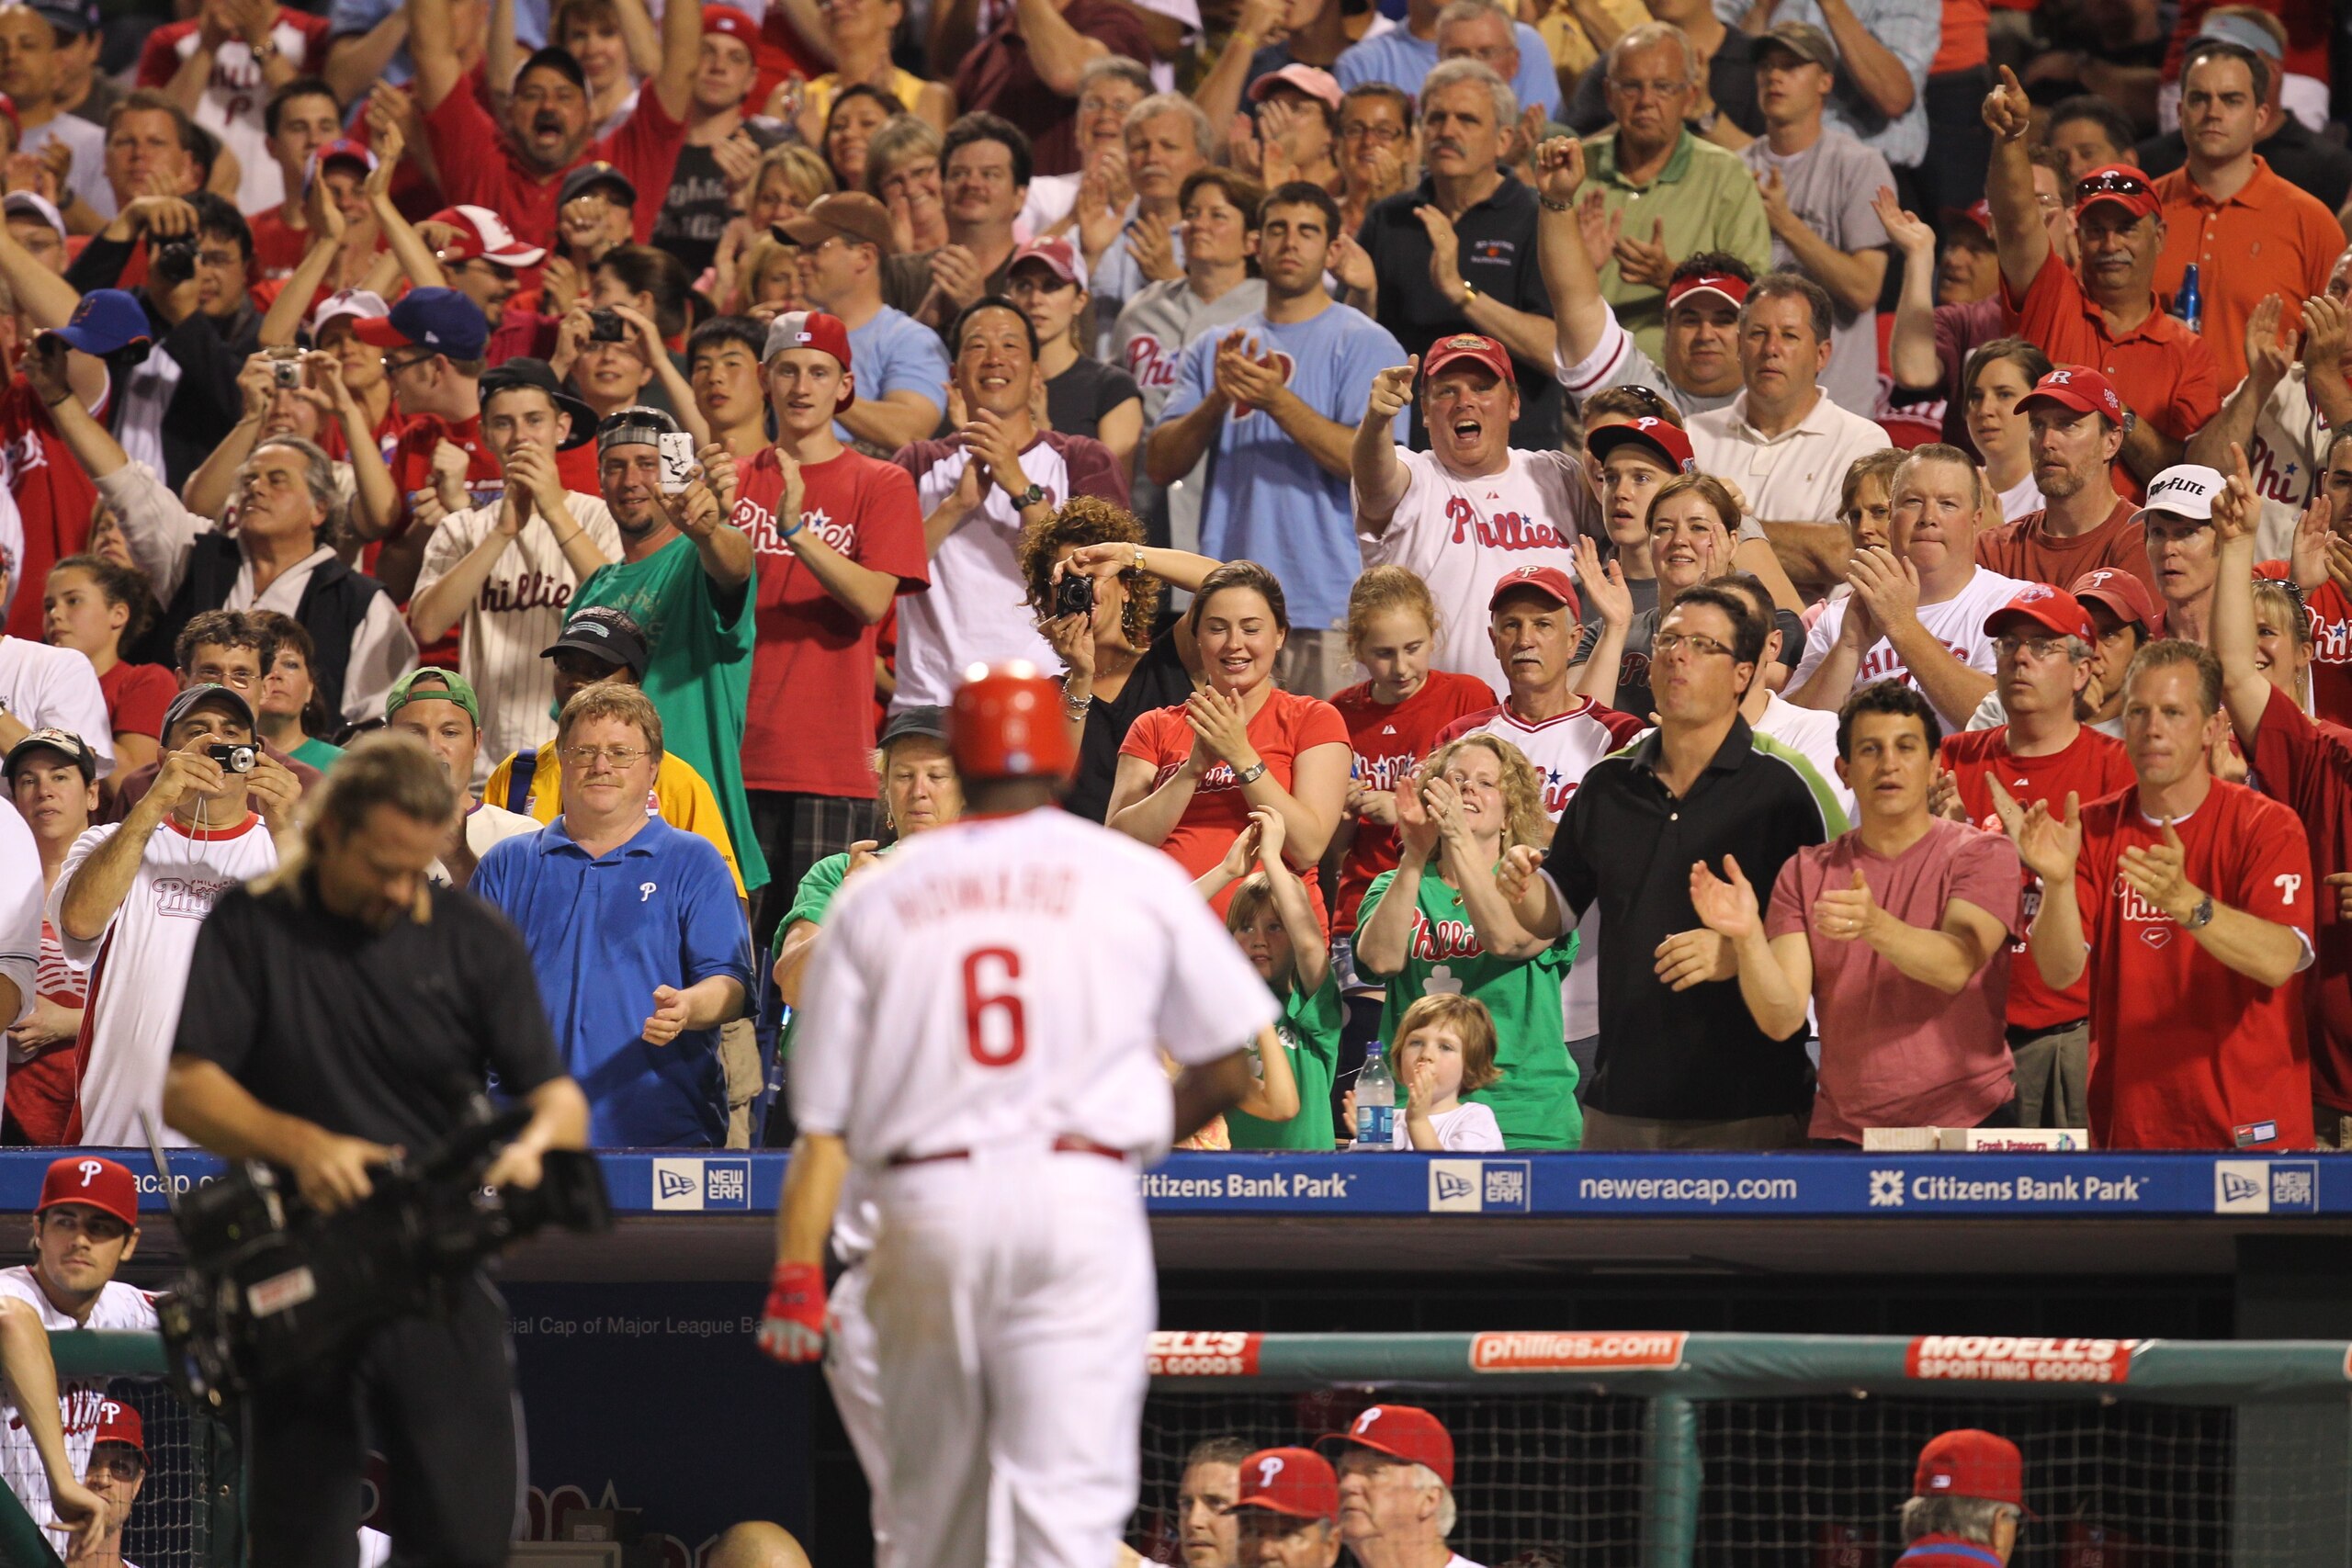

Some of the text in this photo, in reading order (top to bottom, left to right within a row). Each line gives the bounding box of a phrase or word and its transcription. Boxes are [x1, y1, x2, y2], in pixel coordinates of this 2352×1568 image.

[2047, 369, 2073, 385] R
[1637, 415, 1658, 432] P
[1445, 494, 1571, 552] Phillies
[1519, 565, 1538, 578] P
[2092, 571, 2114, 588] P
[480, 570, 571, 614] hillie
[639, 881, 658, 902] P
[2273, 874, 2302, 907] P
[963, 944, 1028, 1068] 6
[78, 1159, 103, 1188] P
[708, 1169, 744, 1185] NEW
[1142, 1175, 1223, 1198] itizens
[1227, 1173, 1289, 1198] Bank
[1486, 1171, 1522, 1187] NEW
[2273, 1172, 2312, 1188] NEW
[708, 1184, 744, 1200] ERA
[1486, 1185, 1522, 1202] ERA
[1579, 1177, 1798, 1205] neweracap.com
[1912, 1175, 2140, 1201] Citizens Bank Park
[2273, 1187, 2312, 1203] ERA
[538, 1316, 577, 1337] Cap
[582, 1316, 602, 1334] of
[607, 1316, 661, 1338] Major
[666, 1316, 735, 1338] League
[1146, 1331, 1249, 1356] ELL'S
[1481, 1335, 1671, 1365] phillies.com
[1919, 1335, 2116, 1361] MODELL'S
[1919, 1359, 2112, 1382] SPORTING GOODS
[100, 1401, 121, 1425] P
[1355, 1407, 1383, 1435] P
[1259, 1457, 1284, 1488] P
